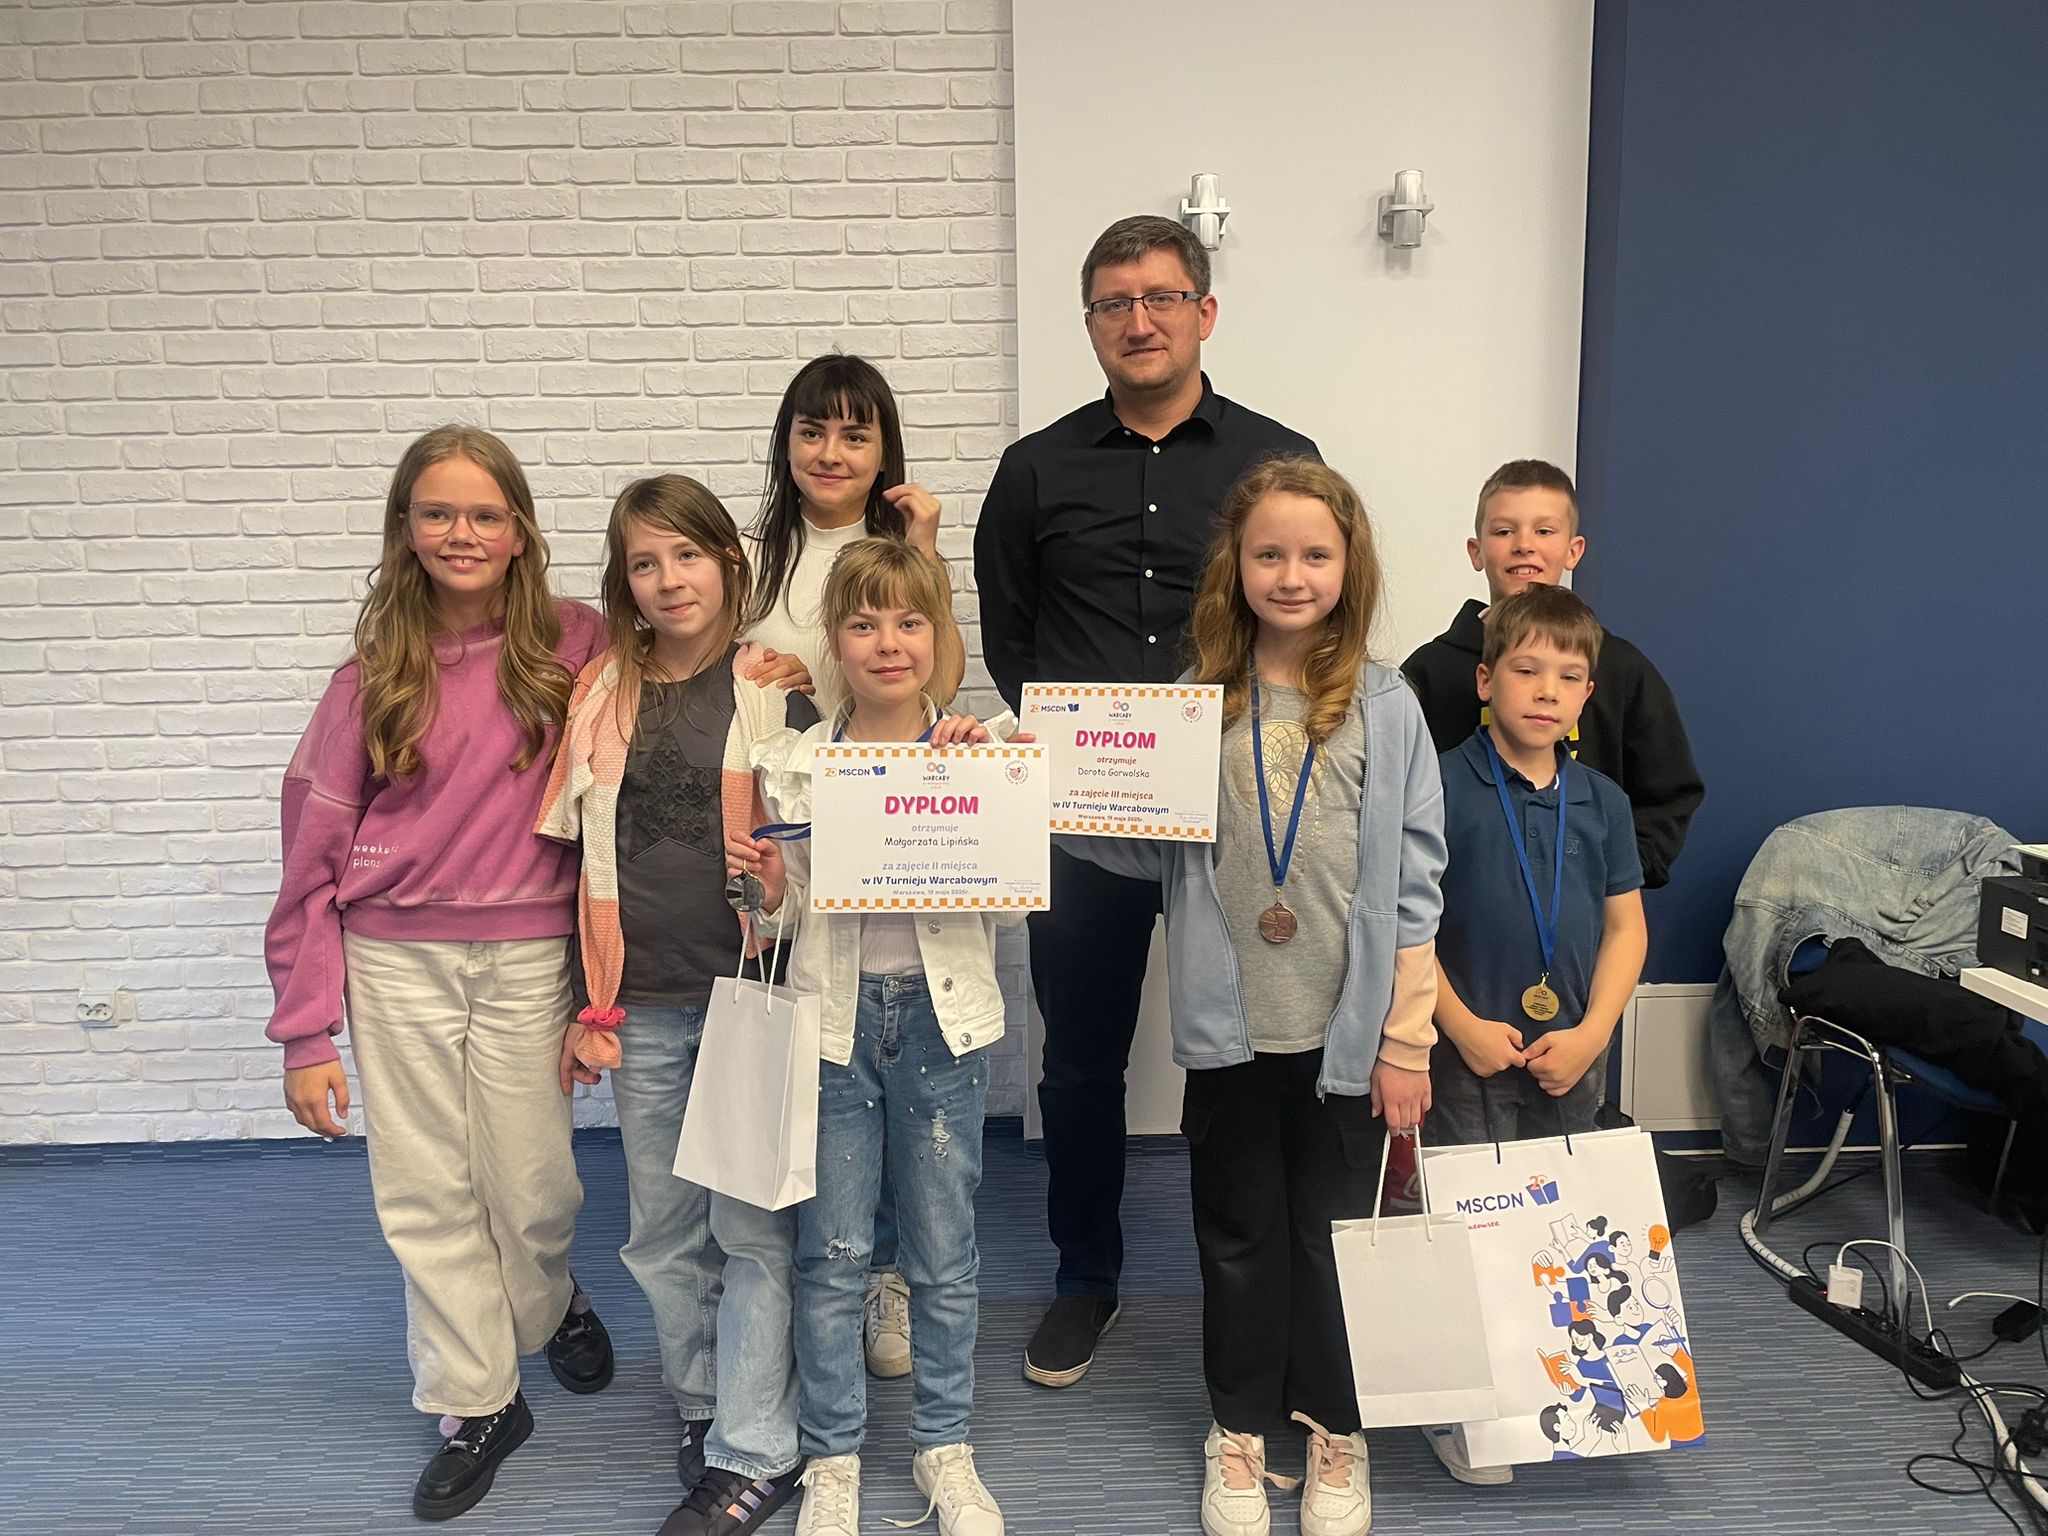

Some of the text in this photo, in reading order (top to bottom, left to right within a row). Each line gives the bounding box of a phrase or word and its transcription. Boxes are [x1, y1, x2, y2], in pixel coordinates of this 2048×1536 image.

[1041, 704, 1066, 713] MSCDN
[1075, 730, 1156, 750] DYPLOM
[1097, 756, 1137, 766] otrzymuje
[838, 768, 870, 776] MSCDN
[1077, 767, 1150, 778] Dorota Garwolska
[1069, 789, 1079, 797] za
[1080, 790, 1109, 799] zajęcie
[1121, 791, 1154, 801] miejsca
[884, 795, 979, 815] DYPLOM
[1062, 801, 1071, 809] IV
[1072, 802, 1107, 812] Turnieju
[1109, 803, 1169, 815] Warcabowym
[911, 823, 959, 834] otrzymuje
[884, 836, 979, 849] Małgorzata Lipińska
[895, 861, 930, 872] zajęcie
[932, 861, 938, 870] II
[940, 861, 978, 872] miejsca
[862, 877, 870, 885] w
[872, 876, 883, 885] IV
[886, 876, 926, 887] Turnieju
[929, 876, 998, 886] Warcabowym
[1456, 1191, 1524, 1215] MSCDN
